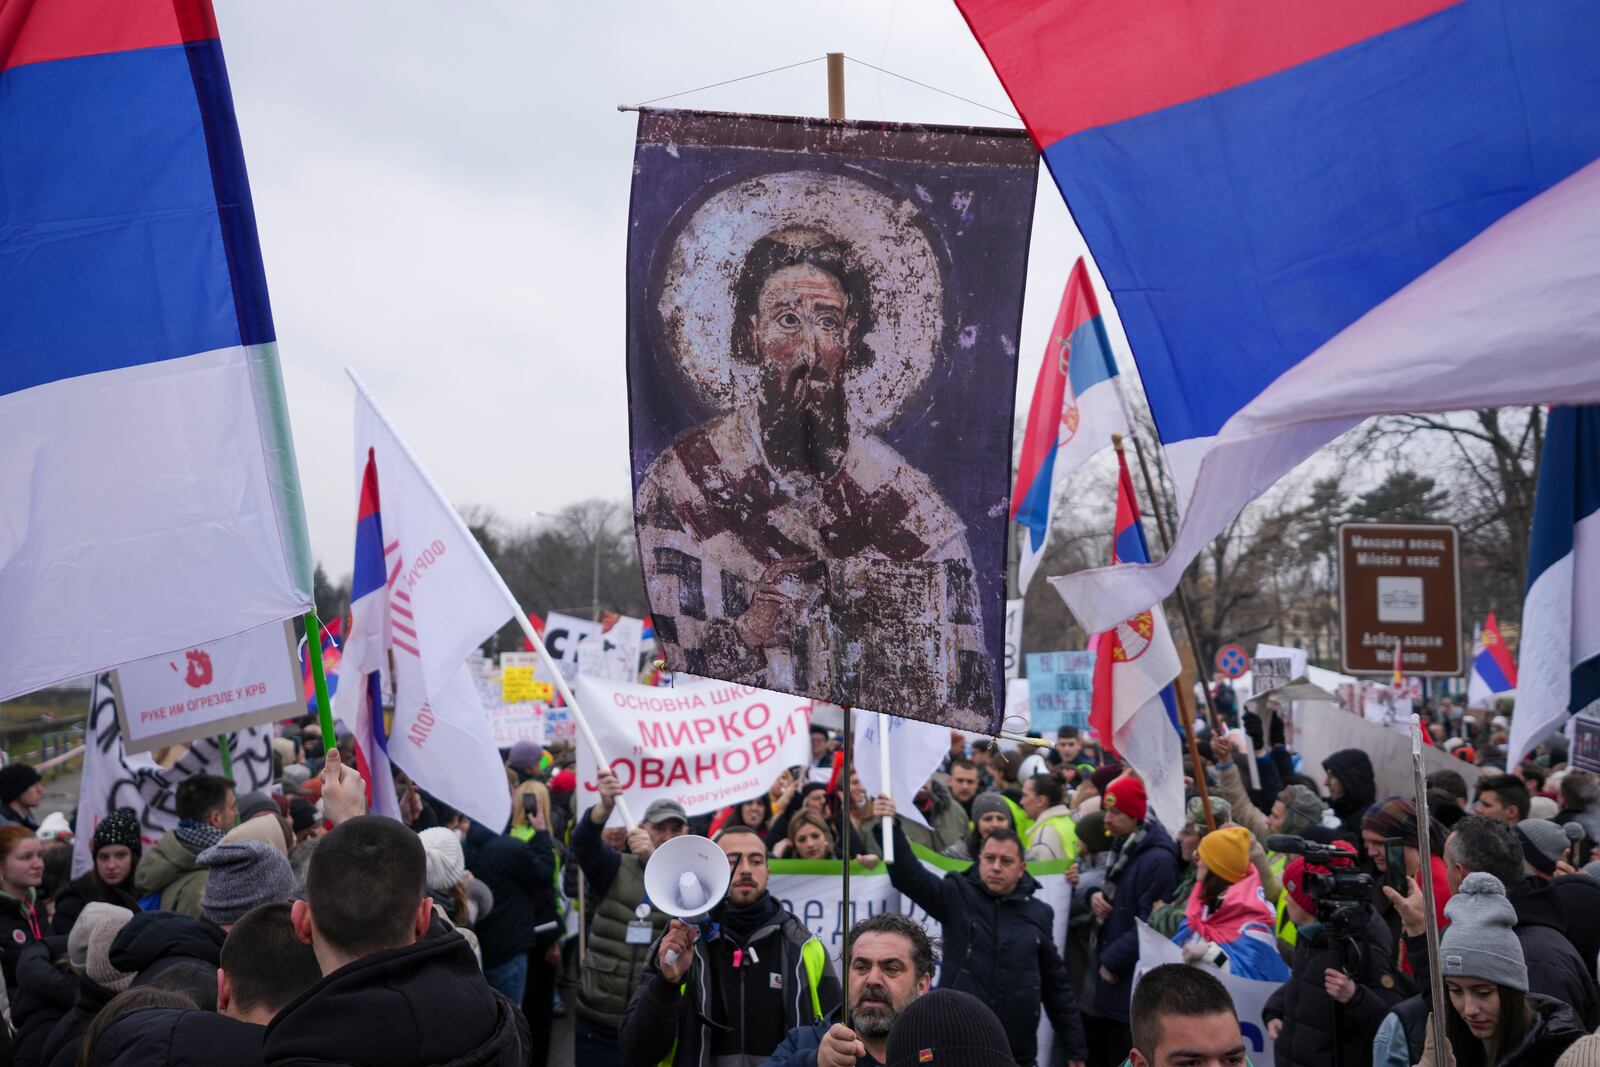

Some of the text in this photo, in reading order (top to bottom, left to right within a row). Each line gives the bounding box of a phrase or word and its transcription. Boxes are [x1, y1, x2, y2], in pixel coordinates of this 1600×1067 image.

[1351, 535, 1446, 551] Милошев венац
[1357, 552, 1441, 567] Milošev venac
[1362, 632, 1443, 648] Добро дошли
[1375, 649, 1428, 663] Weome
[141, 682, 266, 723] РУКЕ ИМ ОГРЕЗЛЕ У КРВ
[613, 684, 758, 712] ОСНОВНА ШКО
